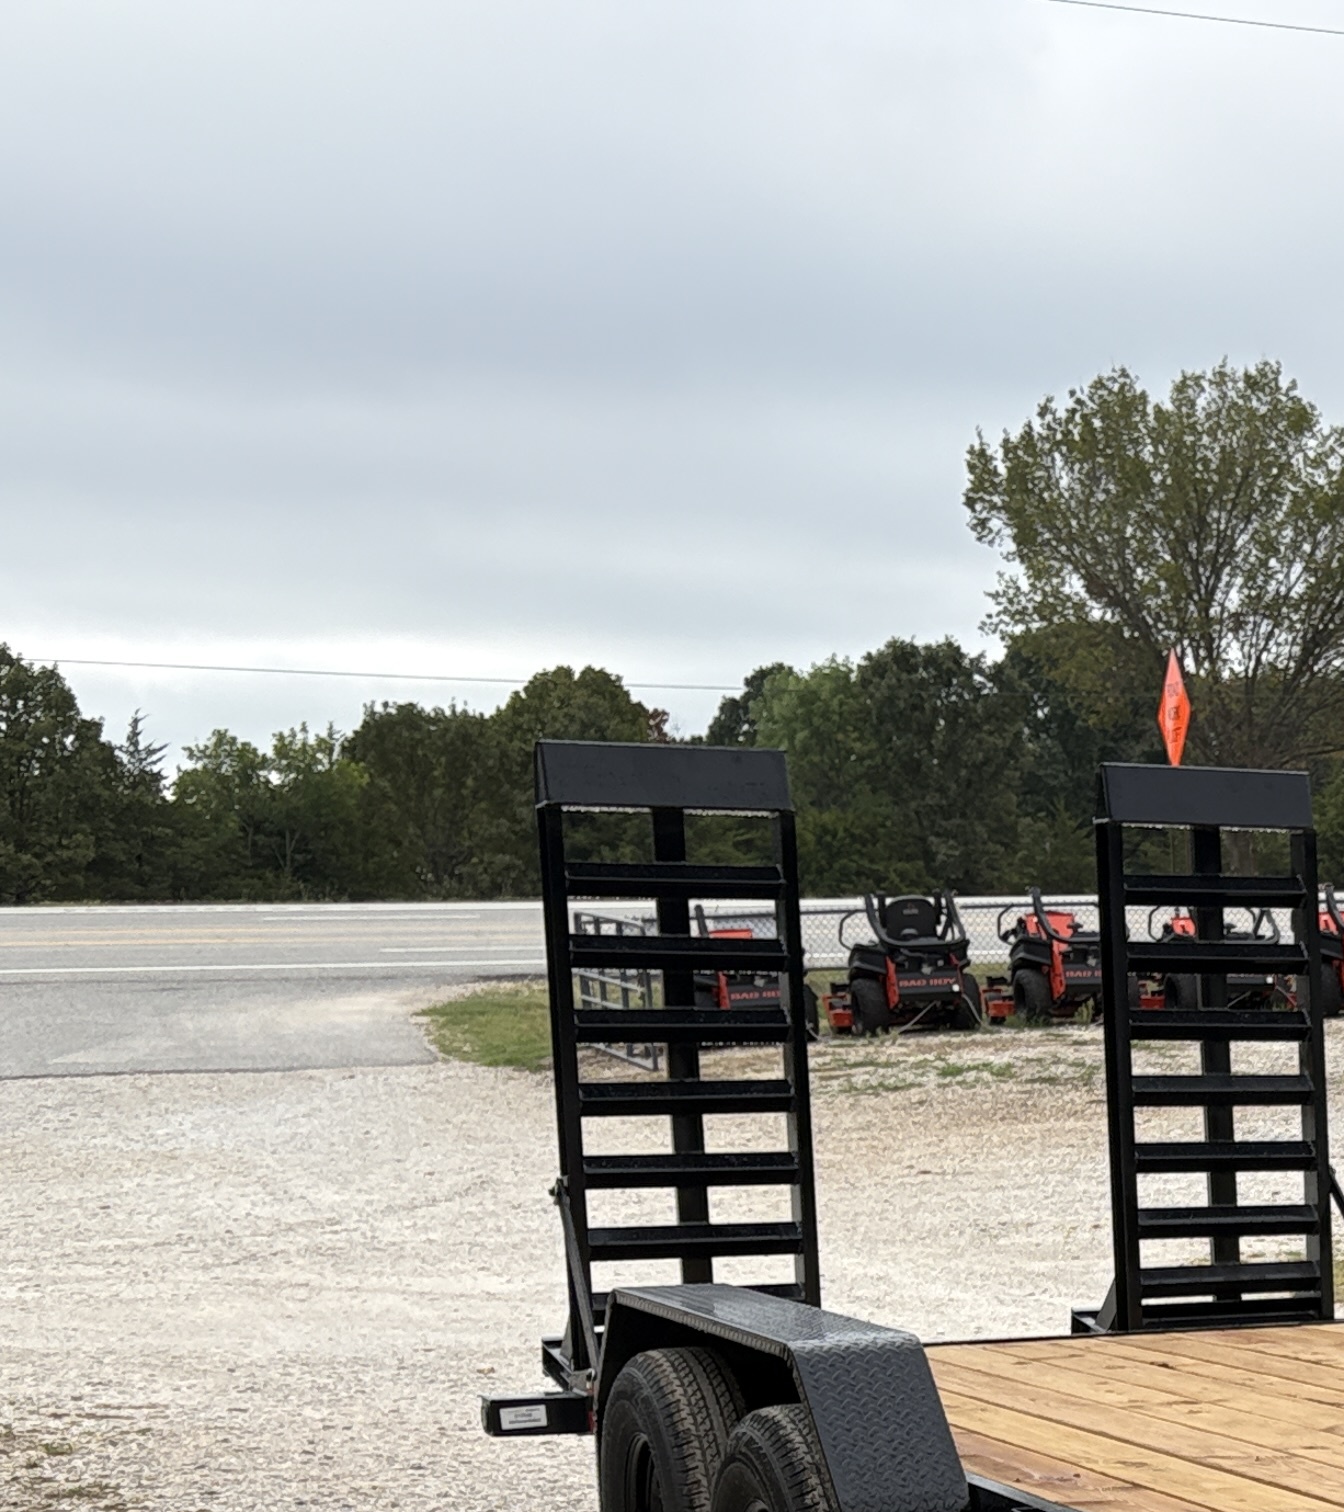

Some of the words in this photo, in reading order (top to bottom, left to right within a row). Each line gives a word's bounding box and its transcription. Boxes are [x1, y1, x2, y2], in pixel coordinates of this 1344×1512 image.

[899, 979, 927, 988] BAD
[929, 978, 956, 986] BOY
[730, 990, 760, 1000] BAD
